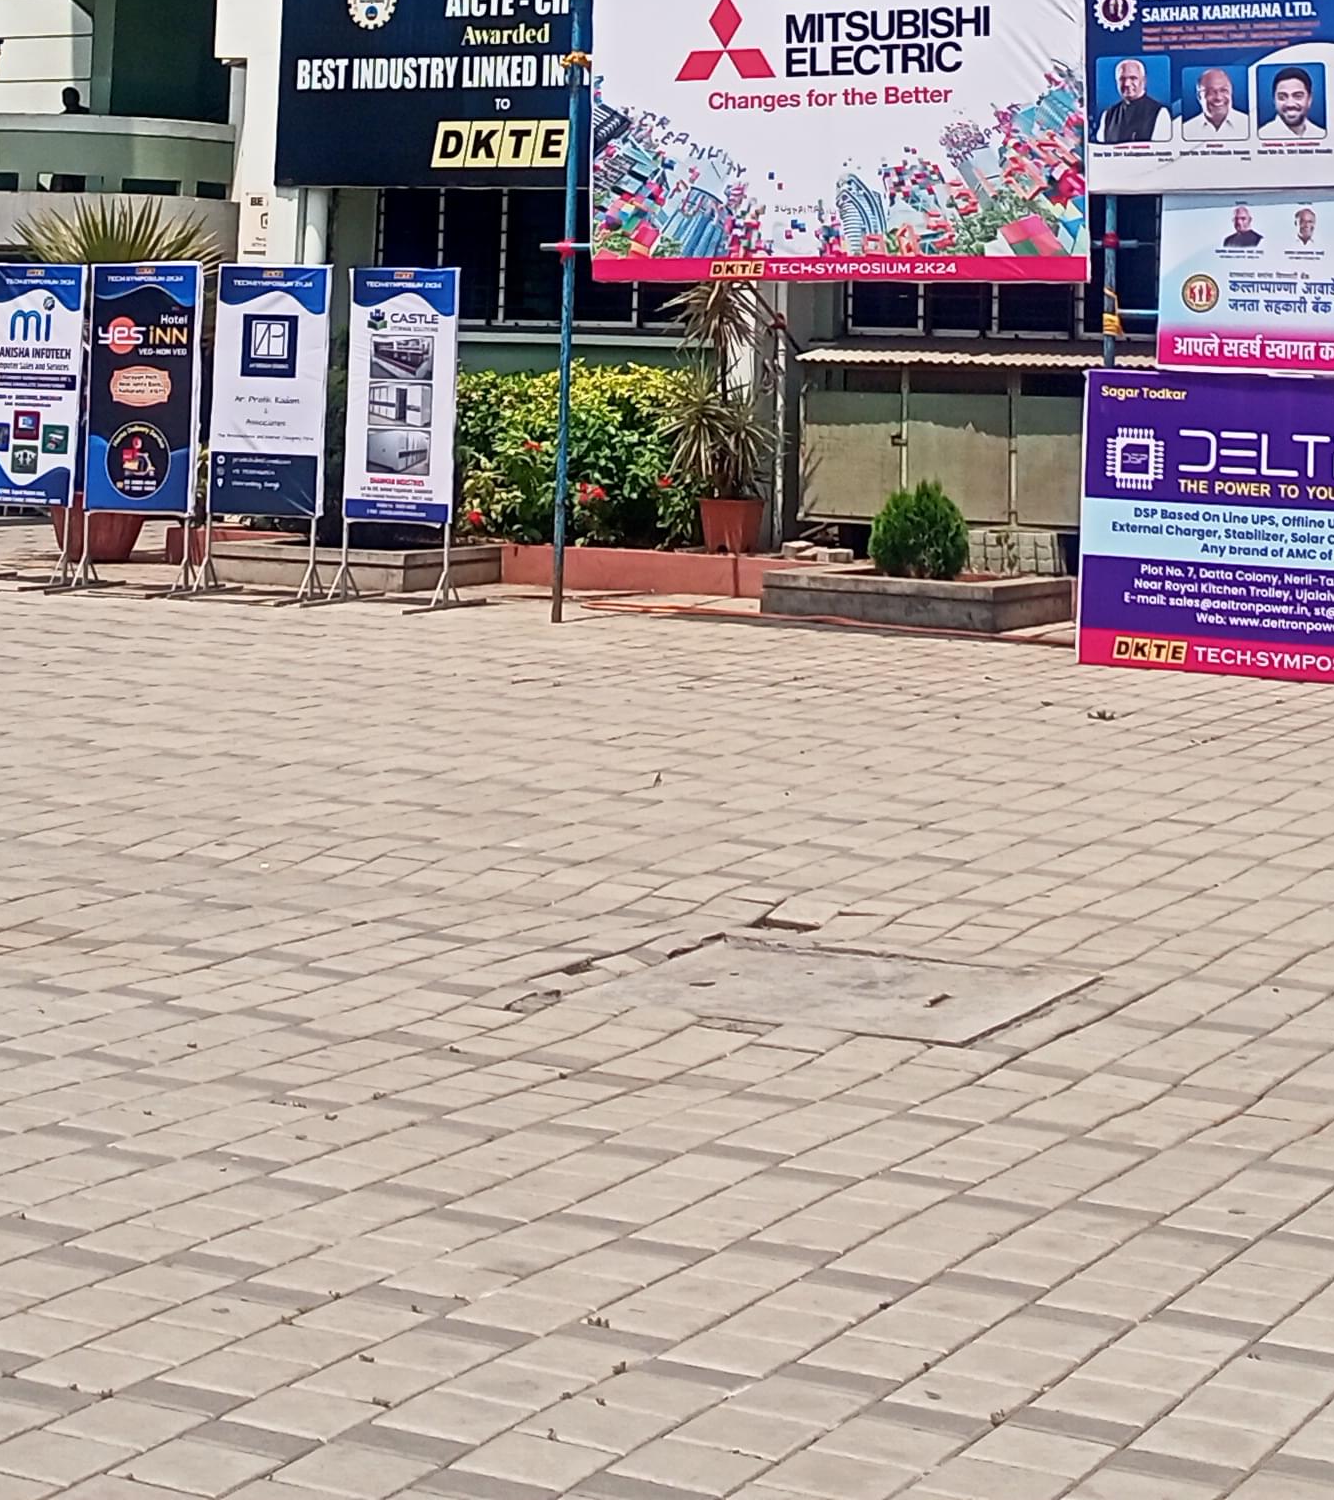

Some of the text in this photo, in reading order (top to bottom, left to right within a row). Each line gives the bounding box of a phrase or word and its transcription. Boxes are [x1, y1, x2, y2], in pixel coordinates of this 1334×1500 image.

[1142, 1, 1316, 22] SAKHAR KARKHANA LTD.
[462, 24, 550, 47] Awarded
[786, 6, 990, 44] MITSUBISHI
[786, 42, 963, 77] ELECTRIC
[708, 86, 952, 112] Changes for the Better
[439, 128, 566, 159] DKTE
[161, 314, 188, 324] Hotel
[391, 313, 438, 324] CASTLE
[98, 326, 187, 344] yes iNN
[32, 348, 71, 359] INFOTECH
[1174, 335, 1218, 357] आपले
[1223, 335, 1262, 358] सहर्ष
[1266, 341, 1316, 361] स्वागत
[1101, 386, 1187, 400] Sagar Todkar
[1178, 479, 1208, 494] THE
[1215, 481, 1271, 497] POWER
[1278, 485, 1299, 498] TO
[1112, 522, 1163, 534] External
[1166, 525, 1221, 540] Charger,
[1225, 529, 1287, 544] Stabilizer,
[1291, 533, 1325, 544] Solar
